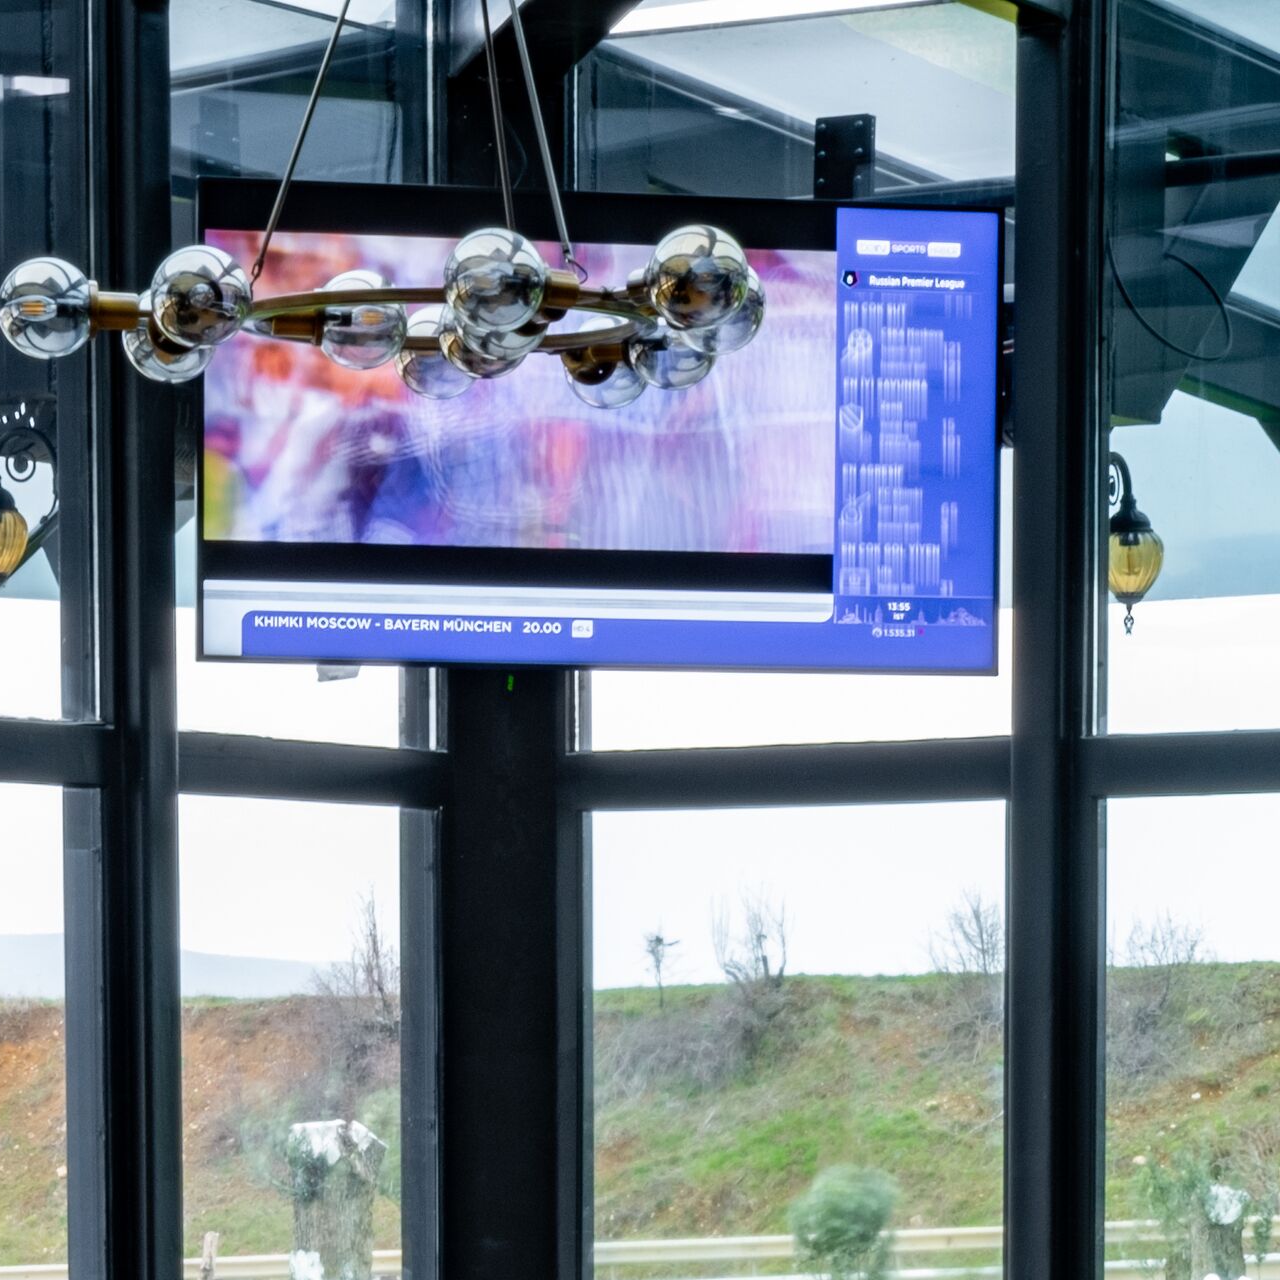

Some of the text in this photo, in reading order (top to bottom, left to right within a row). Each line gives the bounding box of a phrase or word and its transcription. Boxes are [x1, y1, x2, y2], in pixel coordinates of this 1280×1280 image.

[891, 243, 926, 255] SPORTS
[869, 275, 965, 290] Russian Premier League
[887, 601, 911, 612] 13:55
[254, 615, 303, 628] KHIMKI
[306, 616, 371, 630] MOSCOW
[384, 618, 440, 632] BAYERN
[443, 617, 512, 633] MÜNCHEN
[522, 621, 562, 634] 20.00
